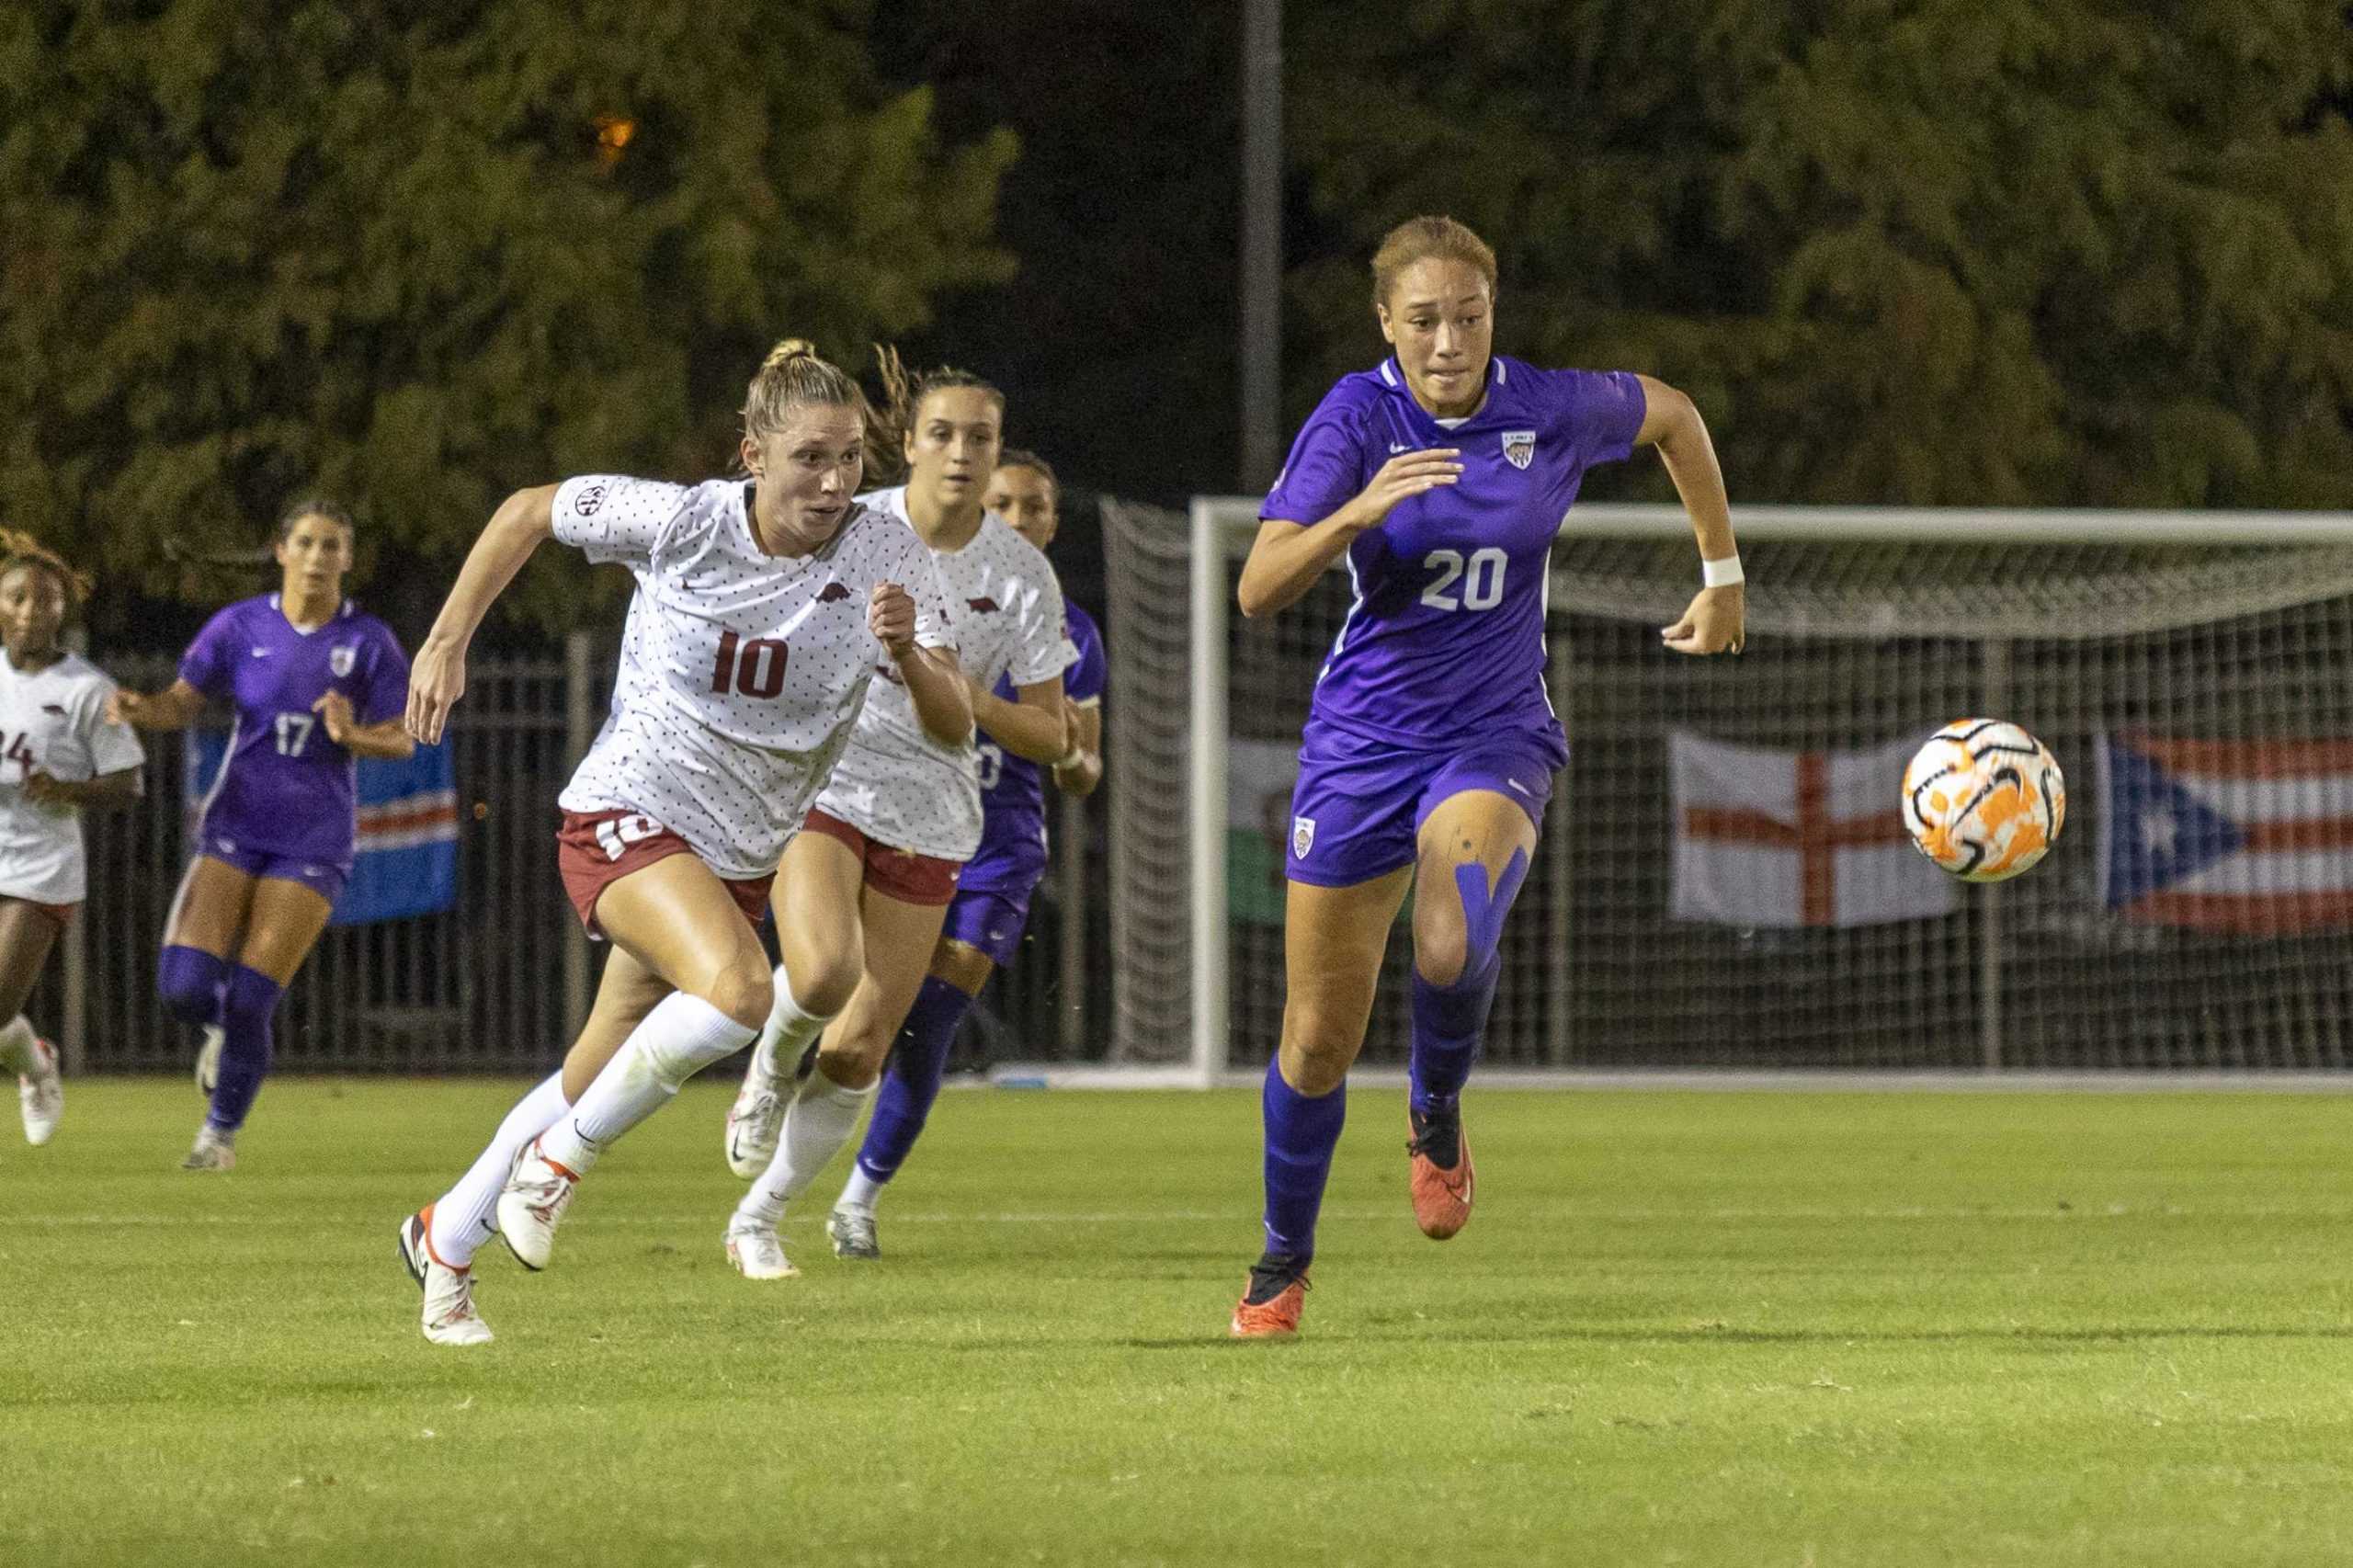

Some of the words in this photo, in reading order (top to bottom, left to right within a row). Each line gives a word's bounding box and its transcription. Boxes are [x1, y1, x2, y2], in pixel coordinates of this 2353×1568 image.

[1421, 547, 1508, 612] 20
[711, 630, 789, 699] 10
[275, 711, 314, 758] 17
